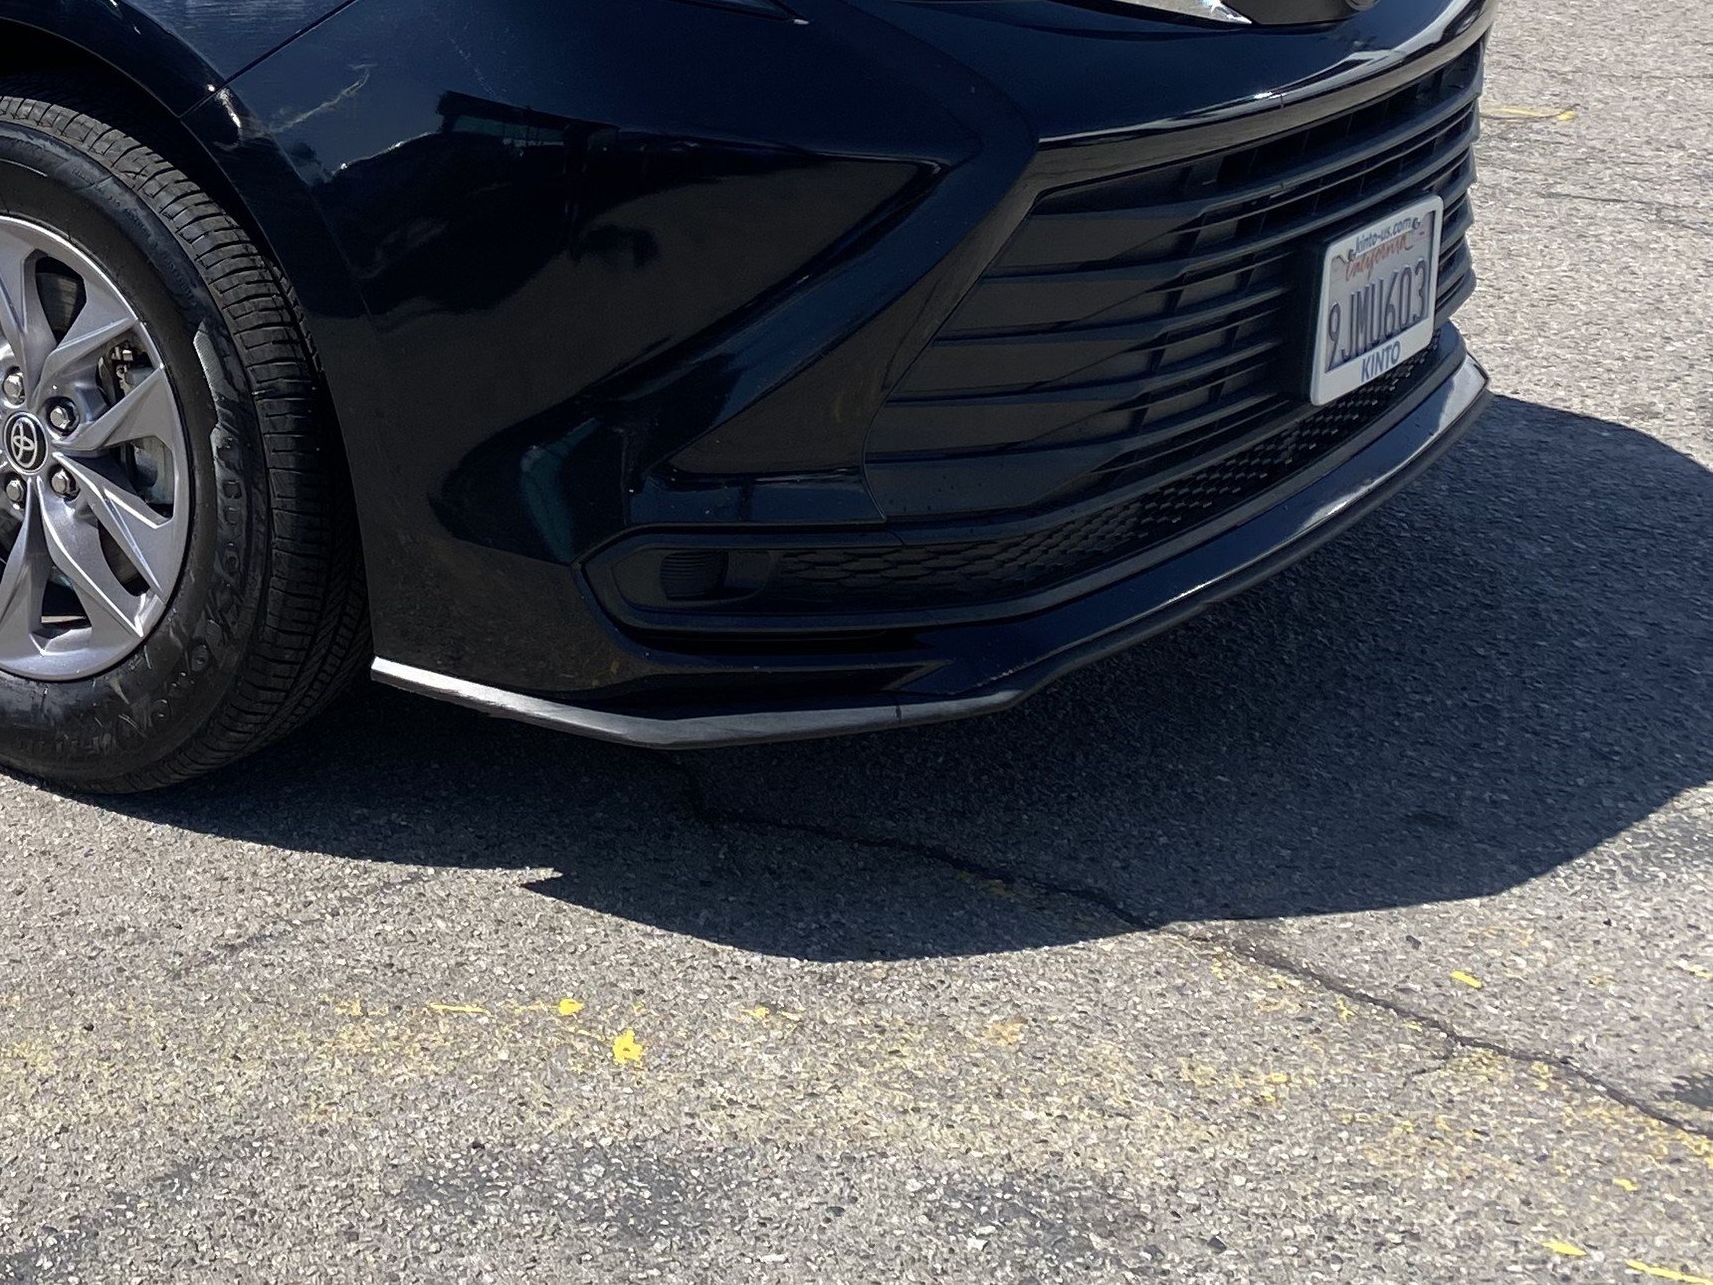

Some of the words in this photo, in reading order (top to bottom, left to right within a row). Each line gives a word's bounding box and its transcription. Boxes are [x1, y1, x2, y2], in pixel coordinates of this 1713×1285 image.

[1355, 218, 1412, 255] kinto-us.com
[1326, 257, 1428, 371] 9JMU603
[1360, 340, 1401, 383] KINTO
